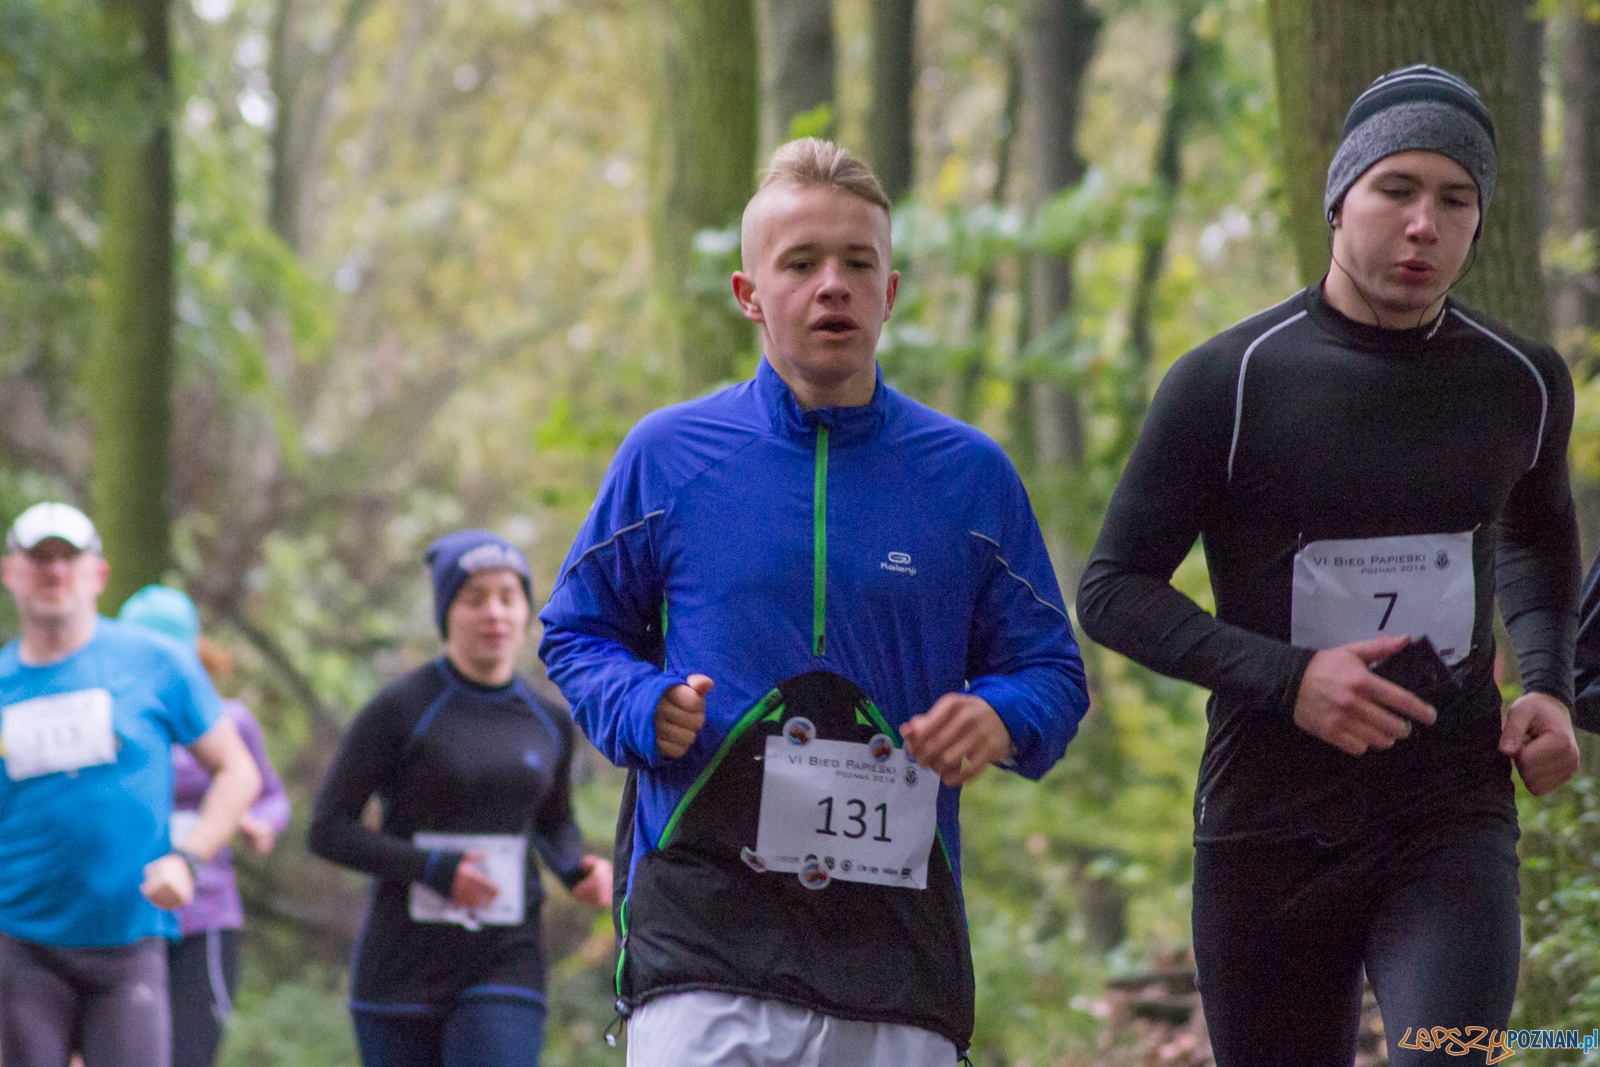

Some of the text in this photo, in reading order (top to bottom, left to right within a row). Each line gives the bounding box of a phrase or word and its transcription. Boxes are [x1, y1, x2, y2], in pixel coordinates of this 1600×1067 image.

[1313, 557, 1328, 566] VI
[1370, 553, 1427, 565] PAPIESKI
[1401, 563, 1427, 573] 2016
[1373, 592, 1399, 632] 7
[787, 754, 803, 765] VI
[845, 759, 897, 775] PAPIESKI
[872, 774, 897, 785] 2016
[815, 795, 892, 843] 131
